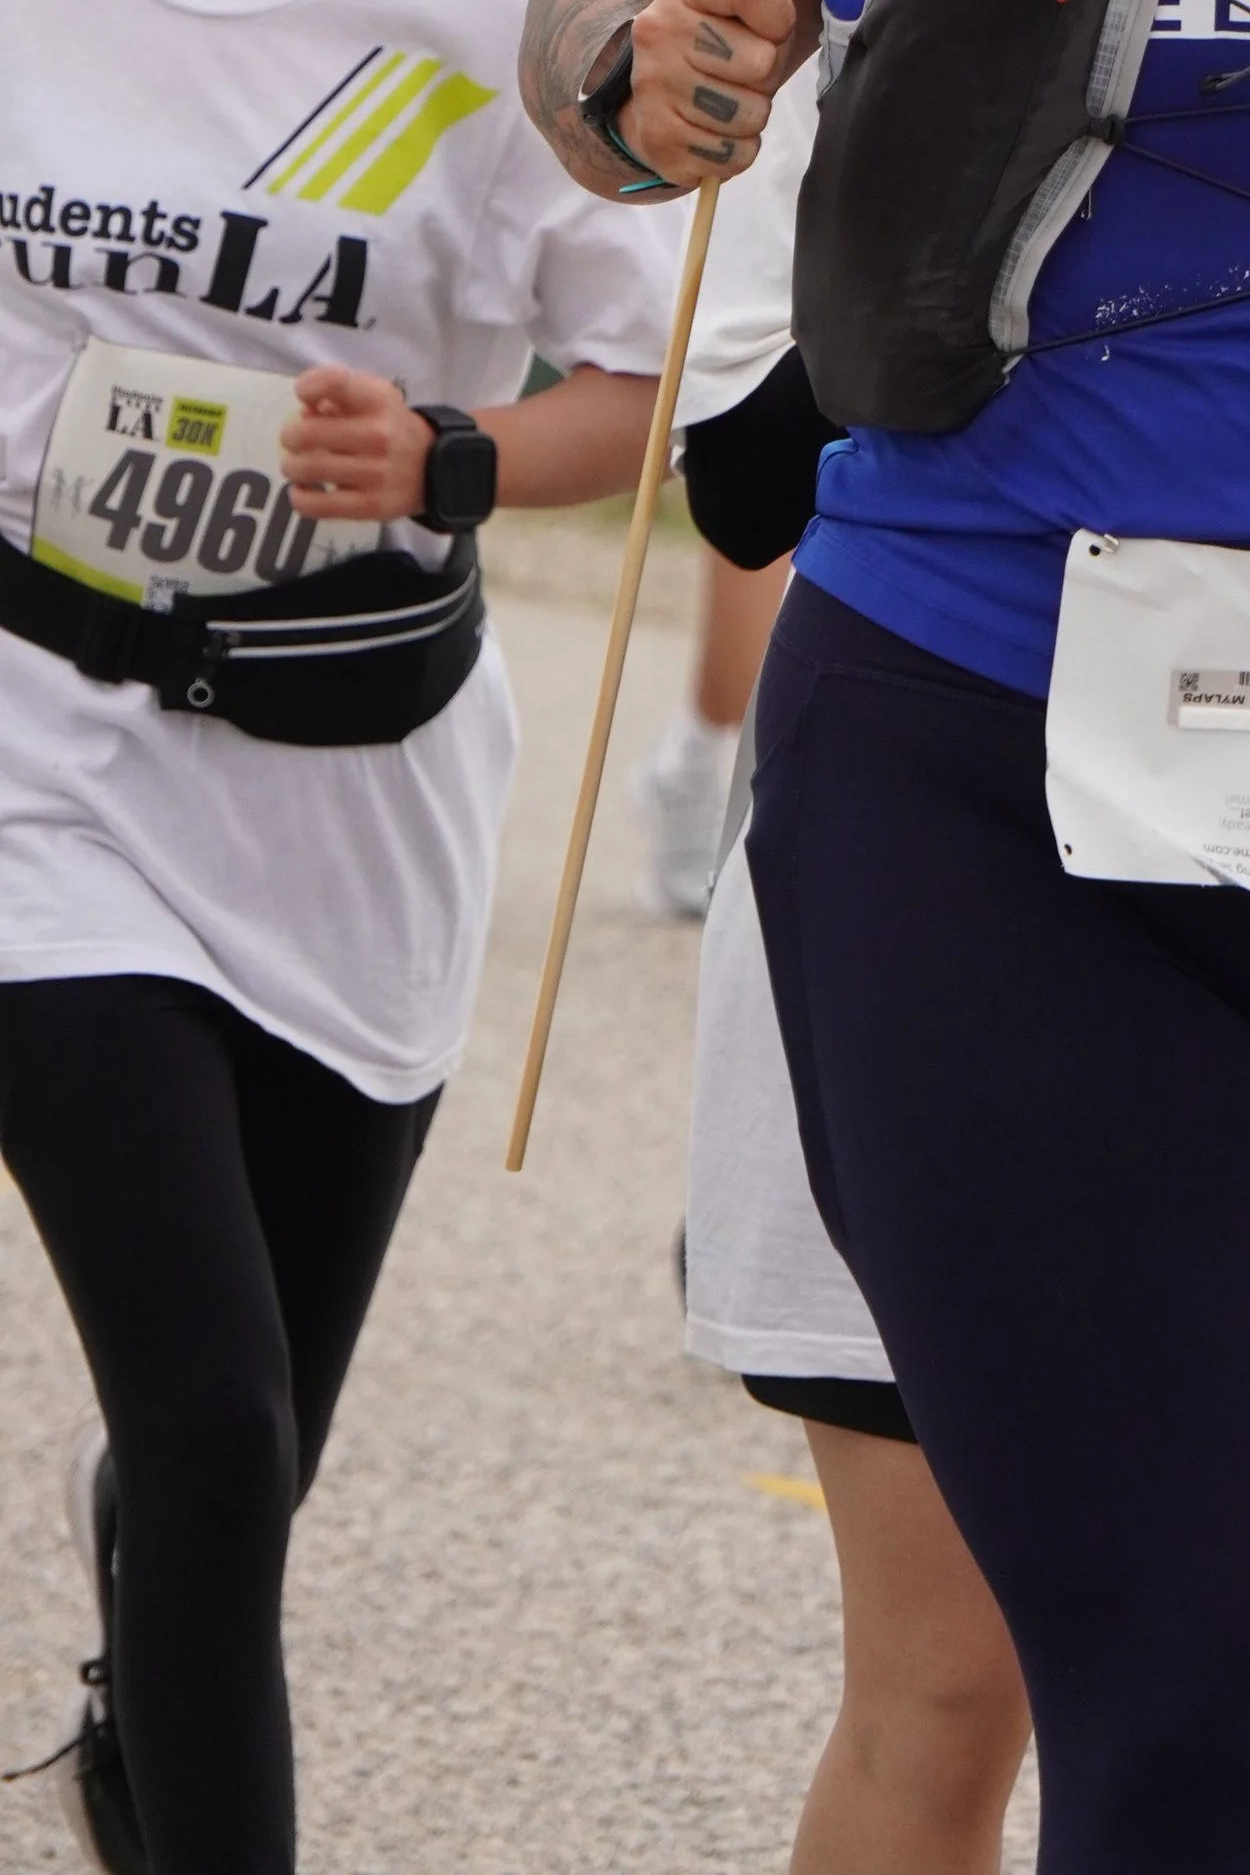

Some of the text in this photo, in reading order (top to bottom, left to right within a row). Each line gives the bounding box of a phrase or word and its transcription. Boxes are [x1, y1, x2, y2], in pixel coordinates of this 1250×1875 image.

[0, 211, 368, 329] un LA
[106, 404, 153, 441] LA
[173, 416, 217, 447] 30K
[1182, 693, 1246, 705] MYLAPS
